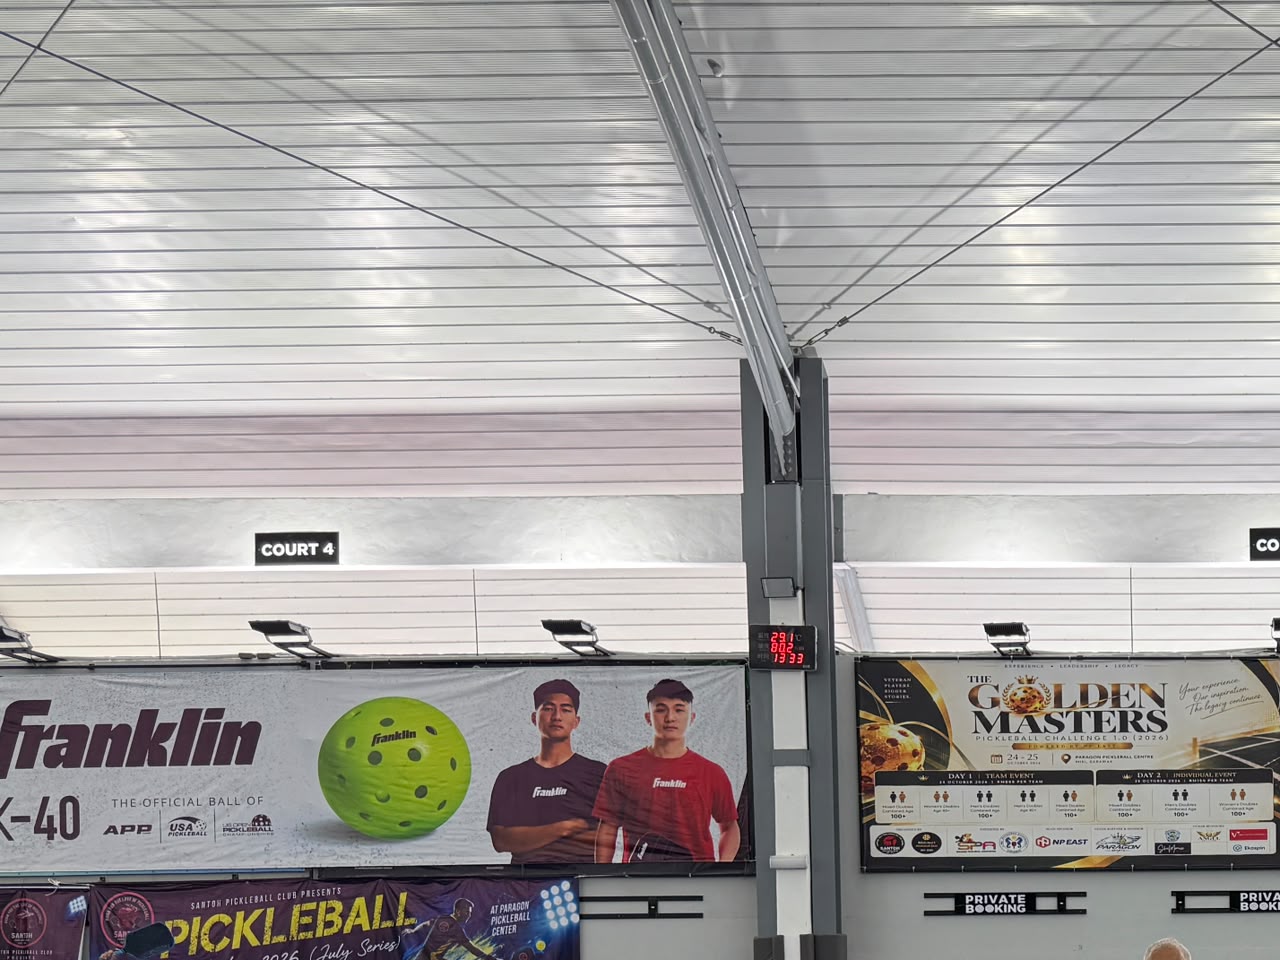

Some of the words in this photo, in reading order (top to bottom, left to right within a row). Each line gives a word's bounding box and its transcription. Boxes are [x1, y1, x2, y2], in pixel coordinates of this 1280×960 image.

[261, 543, 319, 556] COURT
[322, 542, 335, 556] 4
[967, 675, 992, 683] THE
[1179, 682, 1200, 700] Your
[971, 709, 1169, 734] MASTERS
[112, 799, 137, 808] THE
[142, 797, 202, 808] OFFICIAL
[209, 796, 241, 806] BALL
[247, 796, 264, 806] OF
[103, 824, 152, 835] APP
[169, 823, 193, 832] USA
[190, 900, 222, 910] SANTOH
[225, 893, 274, 906] PICKLEBALL
[277, 891, 297, 901] CLUB
[301, 887, 342, 898] PRESENTS
[965, 894, 1026, 905] PRIVATE
[490, 904, 498, 914] AT
[499, 901, 530, 913] PARAGON
[965, 904, 1026, 914] BOOKING
[490, 911, 531, 926] PICKLEBALL
[160, 892, 417, 960] PICKLEBALL
[492, 924, 517, 937] CENTER
[357, 935, 401, 958] Series)
